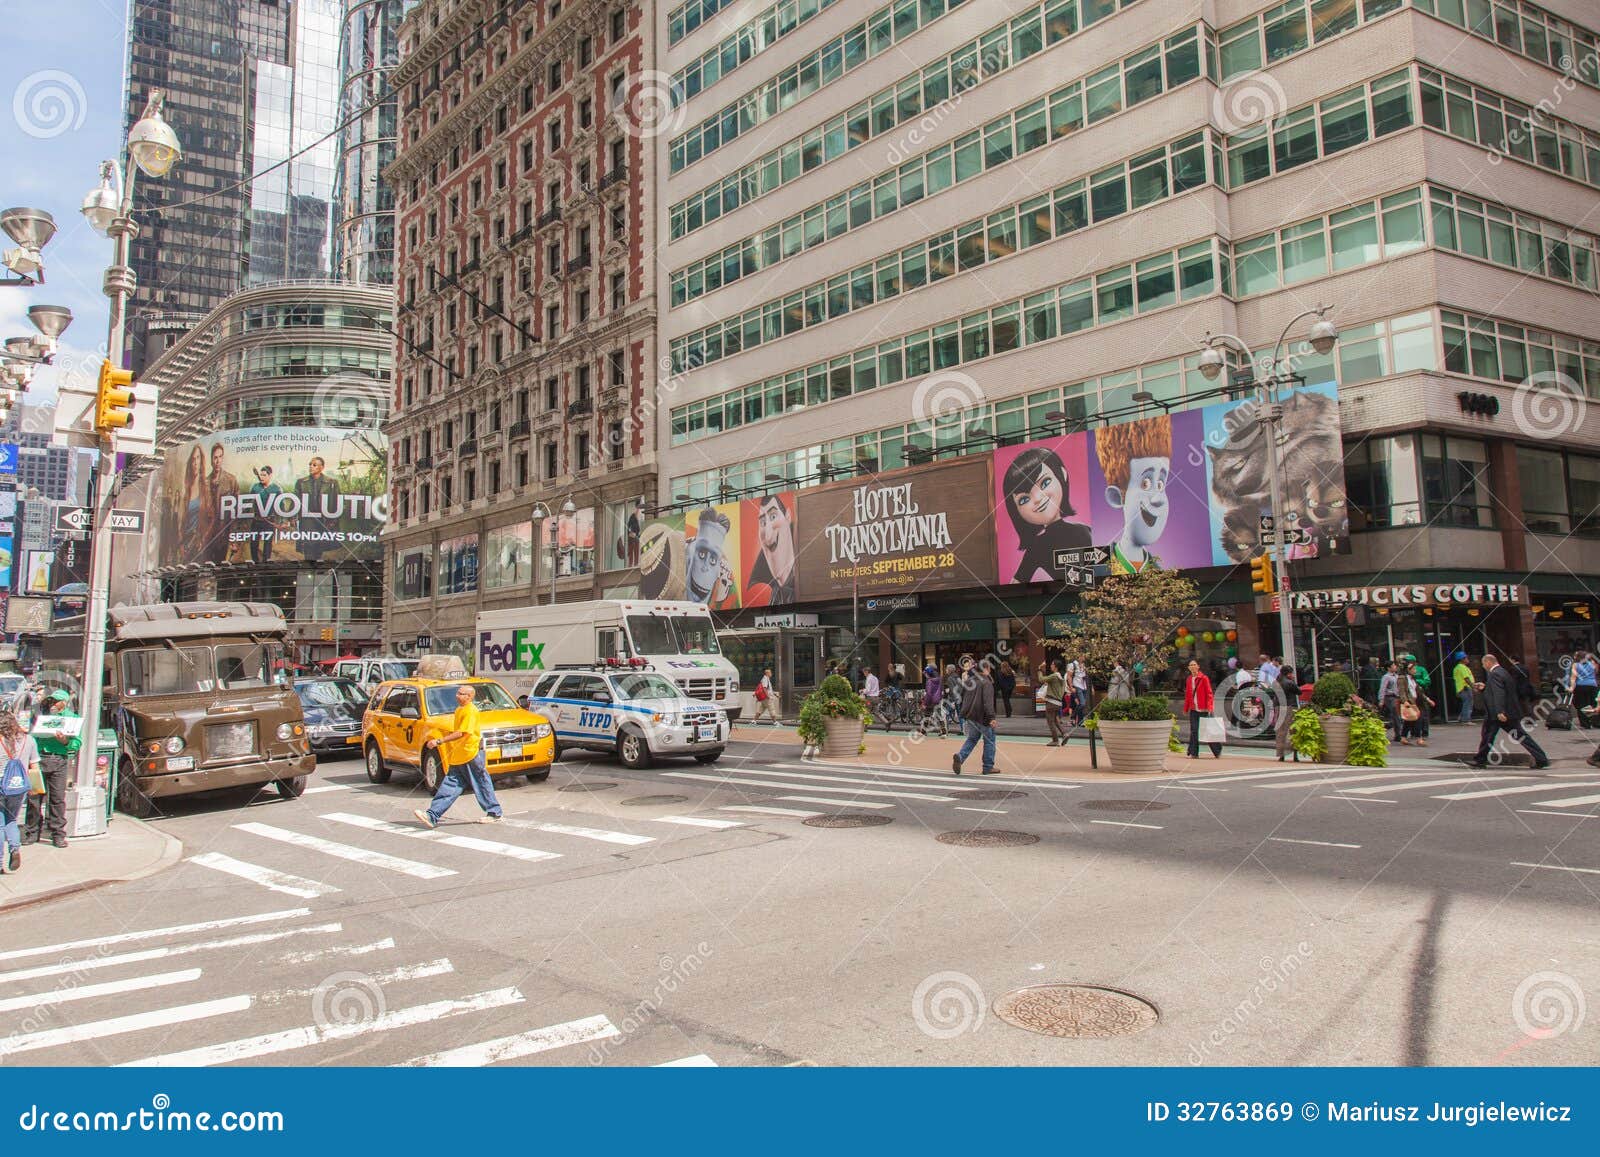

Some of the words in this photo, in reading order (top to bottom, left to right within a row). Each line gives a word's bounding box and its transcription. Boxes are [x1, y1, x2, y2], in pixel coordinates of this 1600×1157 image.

[231, 435, 250, 445] years
[251, 434, 272, 442] after
[274, 432, 289, 441] the
[270, 443, 320, 453] everything.
[853, 482, 919, 525] HOTEL
[229, 532, 257, 542] SEPT
[260, 532, 273, 541] 17
[280, 532, 345, 541] MONDAYS
[347, 533, 377, 542] 10PM
[825, 511, 953, 564] TRANSYLVANIA
[830, 570, 840, 578] IN
[840, 566, 872, 577] THEATERS
[873, 555, 936, 574] SEPTEMBER
[939, 553, 955, 567] 28
[1062, 554, 1079, 563] ONE
[1084, 552, 1102, 560] WAY
[1289, 585, 1428, 609] TARBUCKS
[1434, 585, 1519, 602] COFFEE
[480, 629, 545, 671] FedEx
[579, 711, 612, 728] NYPD
